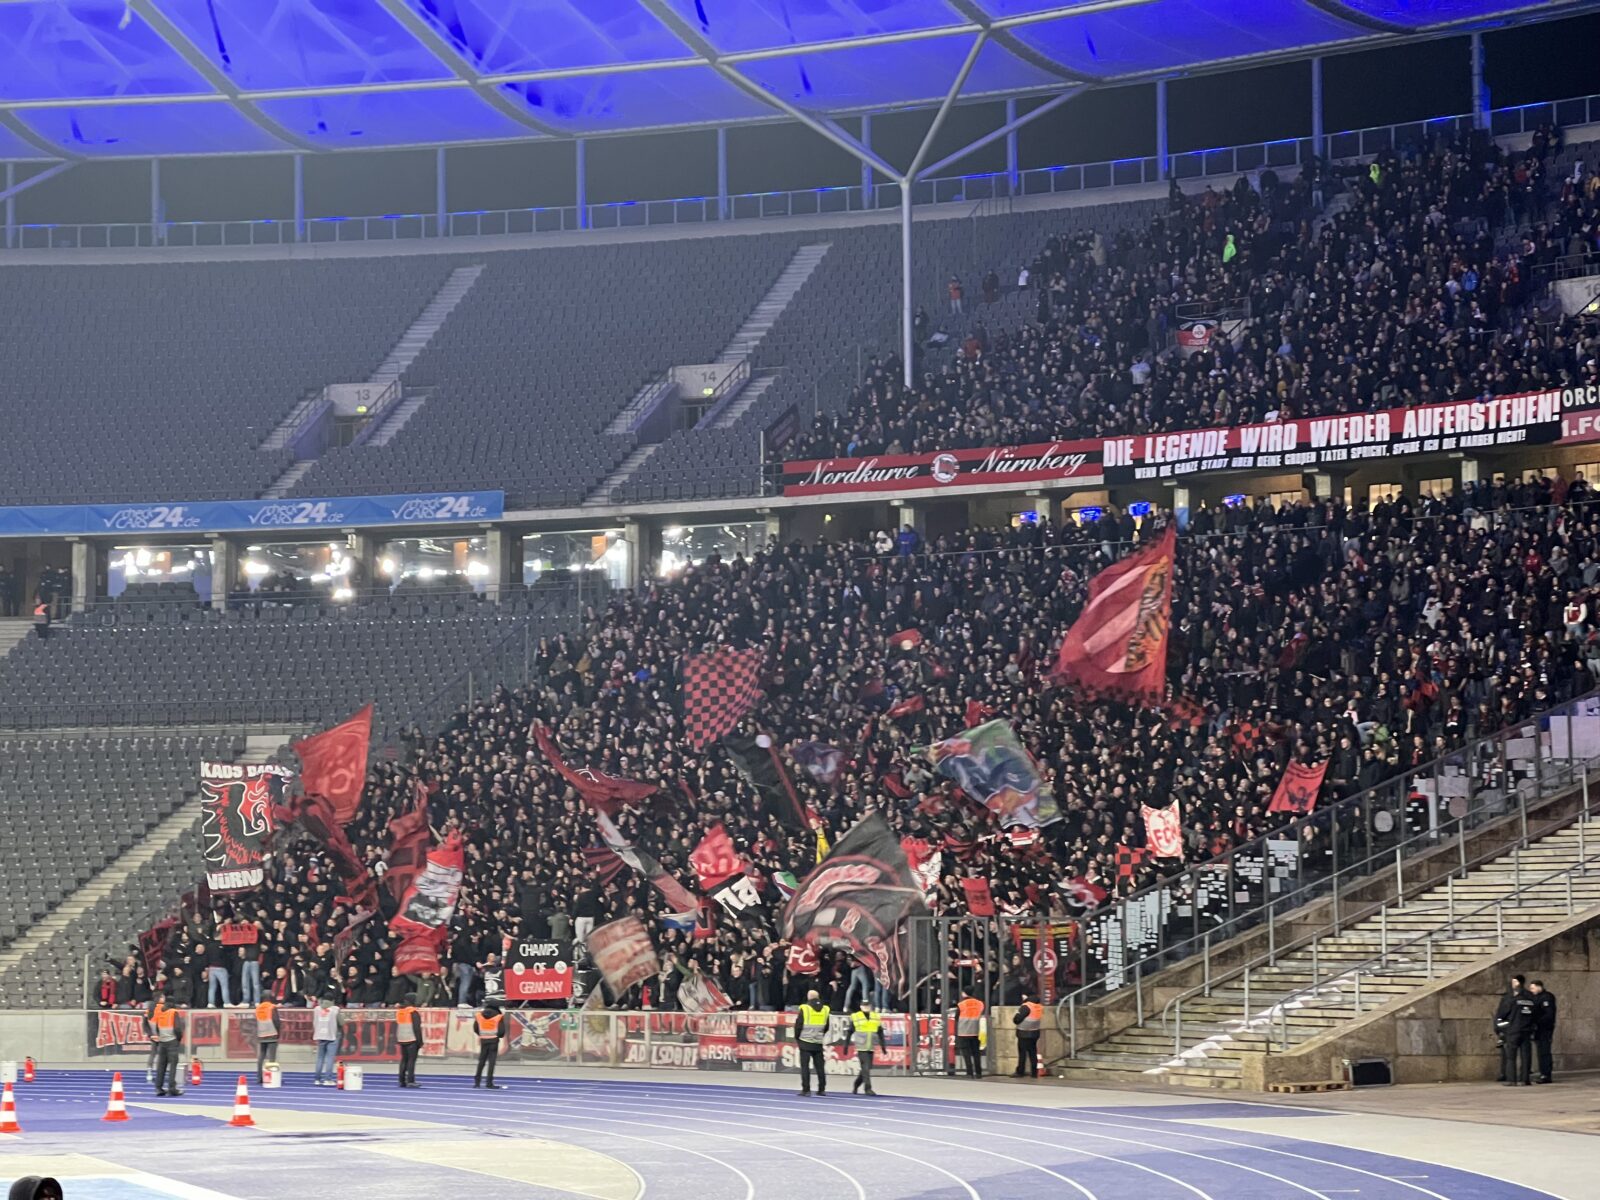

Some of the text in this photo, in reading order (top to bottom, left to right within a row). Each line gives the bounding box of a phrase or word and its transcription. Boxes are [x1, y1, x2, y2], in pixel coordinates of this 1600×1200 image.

[701, 371, 717, 382] 14
[355, 389, 370, 401] 13
[1562, 385, 1600, 408] ORC
[1103, 390, 1561, 467] DIE LEGENDE WIRD WIEDER AUFERSTEHEN!
[800, 443, 1087, 487] Nordkurve Nürnberg
[519, 943, 559, 957] CHAMPS
[533, 962, 547, 975] OF
[519, 981, 564, 994] GERMANY
[624, 1043, 698, 1066] ADLSDORF
